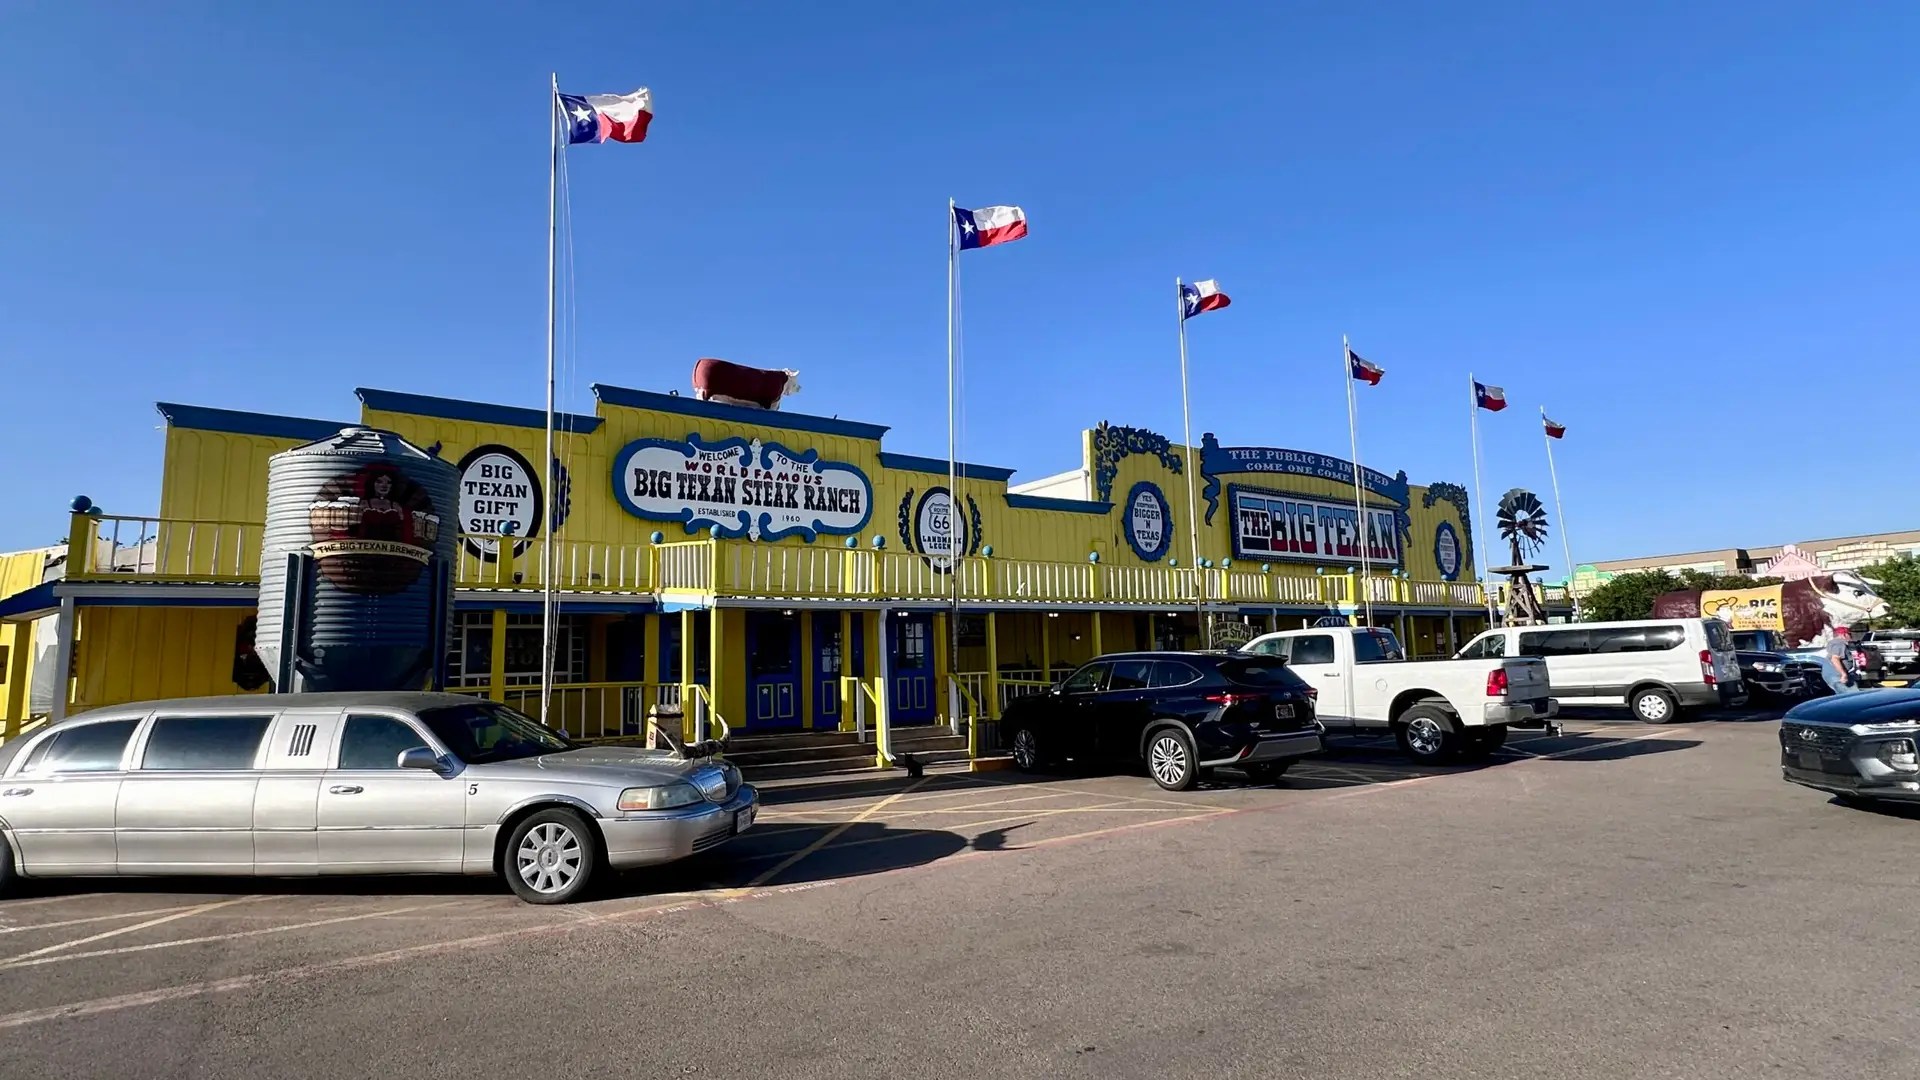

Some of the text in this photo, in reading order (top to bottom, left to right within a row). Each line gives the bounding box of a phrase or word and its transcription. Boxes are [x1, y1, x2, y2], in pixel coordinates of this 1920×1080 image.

[699, 447, 808, 473] WELCOME TO THE
[1228, 450, 1389, 487] THE PUBLIC IS INTED
[481, 464, 513, 479] BIG
[685, 460, 823, 486] WORLD FAMOUS
[1246, 463, 1283, 471] COME
[1288, 464, 1313, 475] ONE
[1317, 468, 1350, 482] COME
[464, 481, 527, 498] TEXAN
[634, 468, 860, 514] BIG TEXAN STEAK RANCH
[474, 500, 518, 515] GIFT
[698, 508, 736, 518] ESTABLISHED
[1134, 508, 1160, 520] BIGGER
[933, 515, 949, 529] 66
[1240, 510, 1270, 536] THE
[1267, 500, 1317, 554] BIG
[1317, 505, 1397, 560] TEXAN
[1136, 530, 1159, 540] TEXAS
[318, 542, 426, 559] THE BIG TEXAN BREWERY
[468, 783, 479, 795] 5
